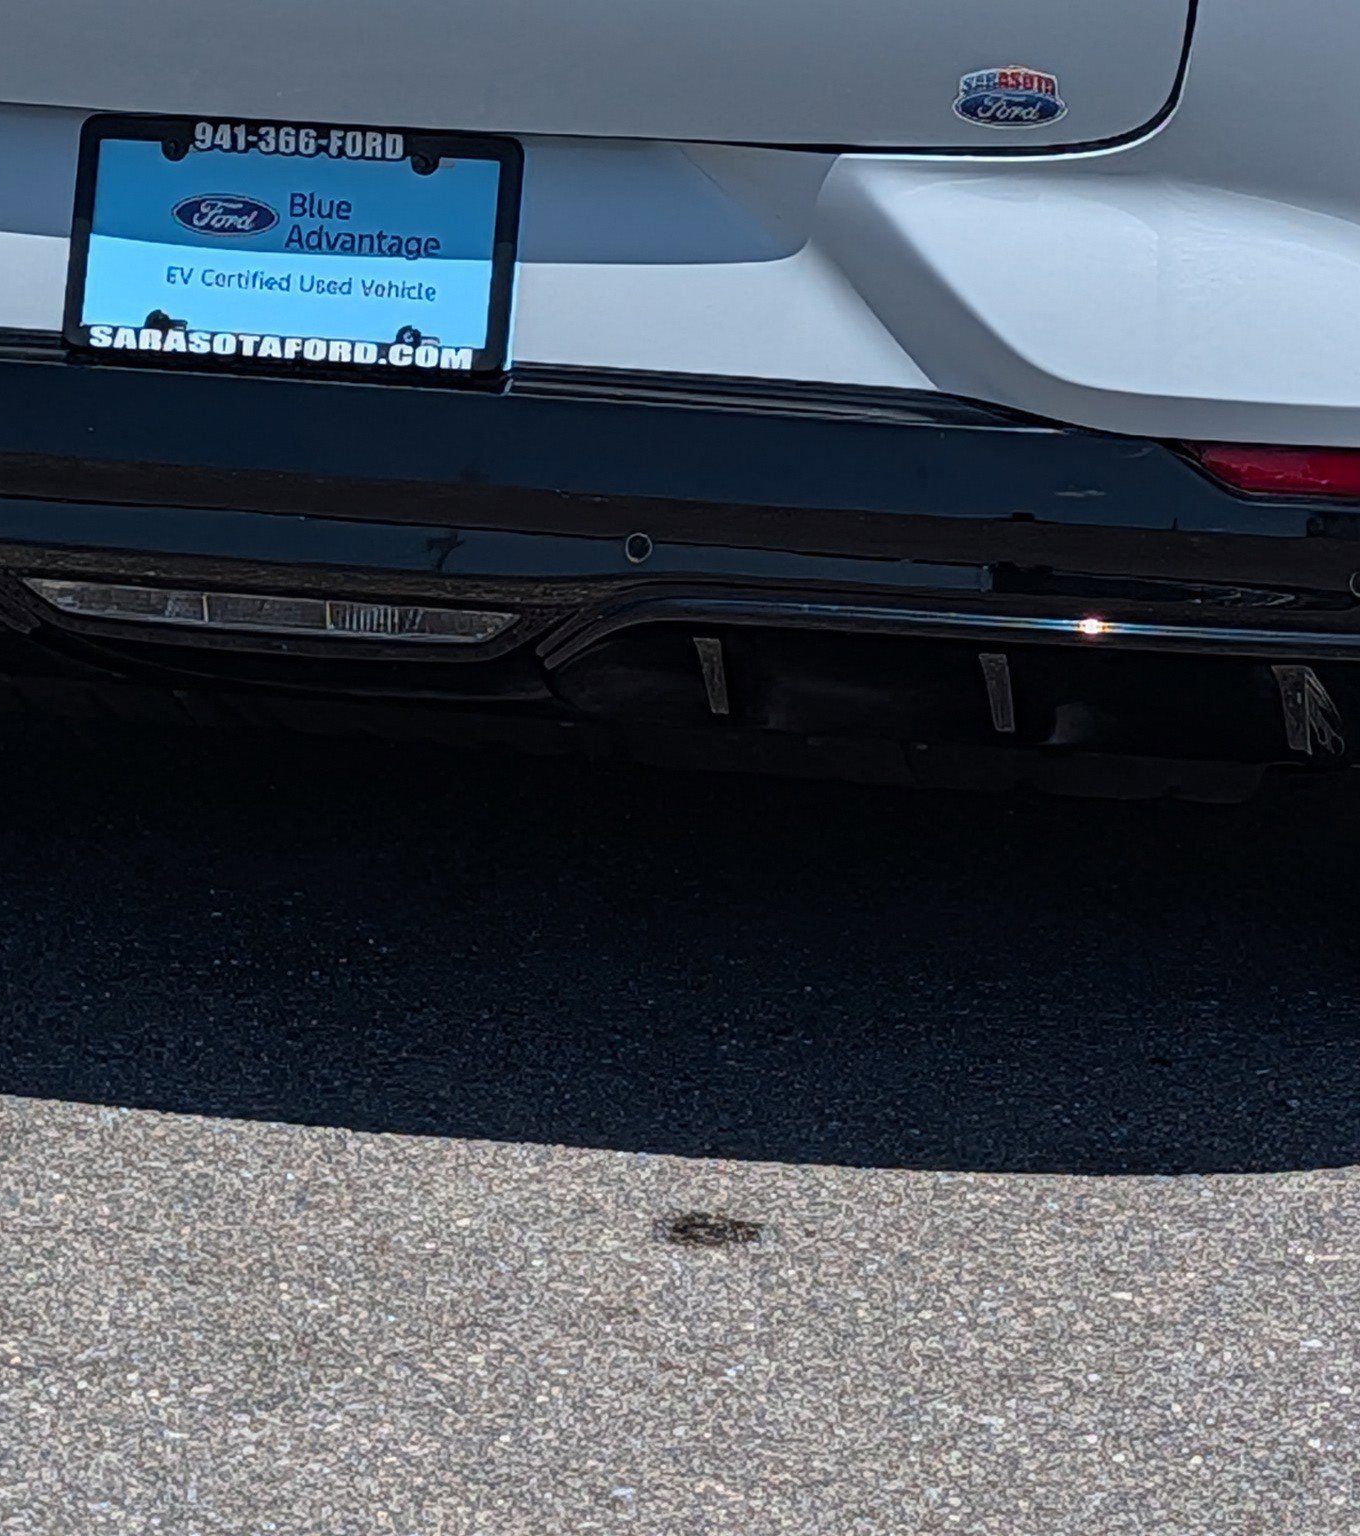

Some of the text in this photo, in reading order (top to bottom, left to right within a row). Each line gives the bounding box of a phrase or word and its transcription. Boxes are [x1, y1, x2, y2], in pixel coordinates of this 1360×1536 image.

[977, 96, 1041, 120] Ford
[194, 122, 404, 160] 941-366-FORD
[192, 200, 255, 232] Ford
[289, 192, 351, 221] Blue
[284, 225, 441, 260] Advantage
[166, 266, 436, 302] EV Certified Used Vehicle
[88, 325, 474, 371] SARASOTAFORD.COM
